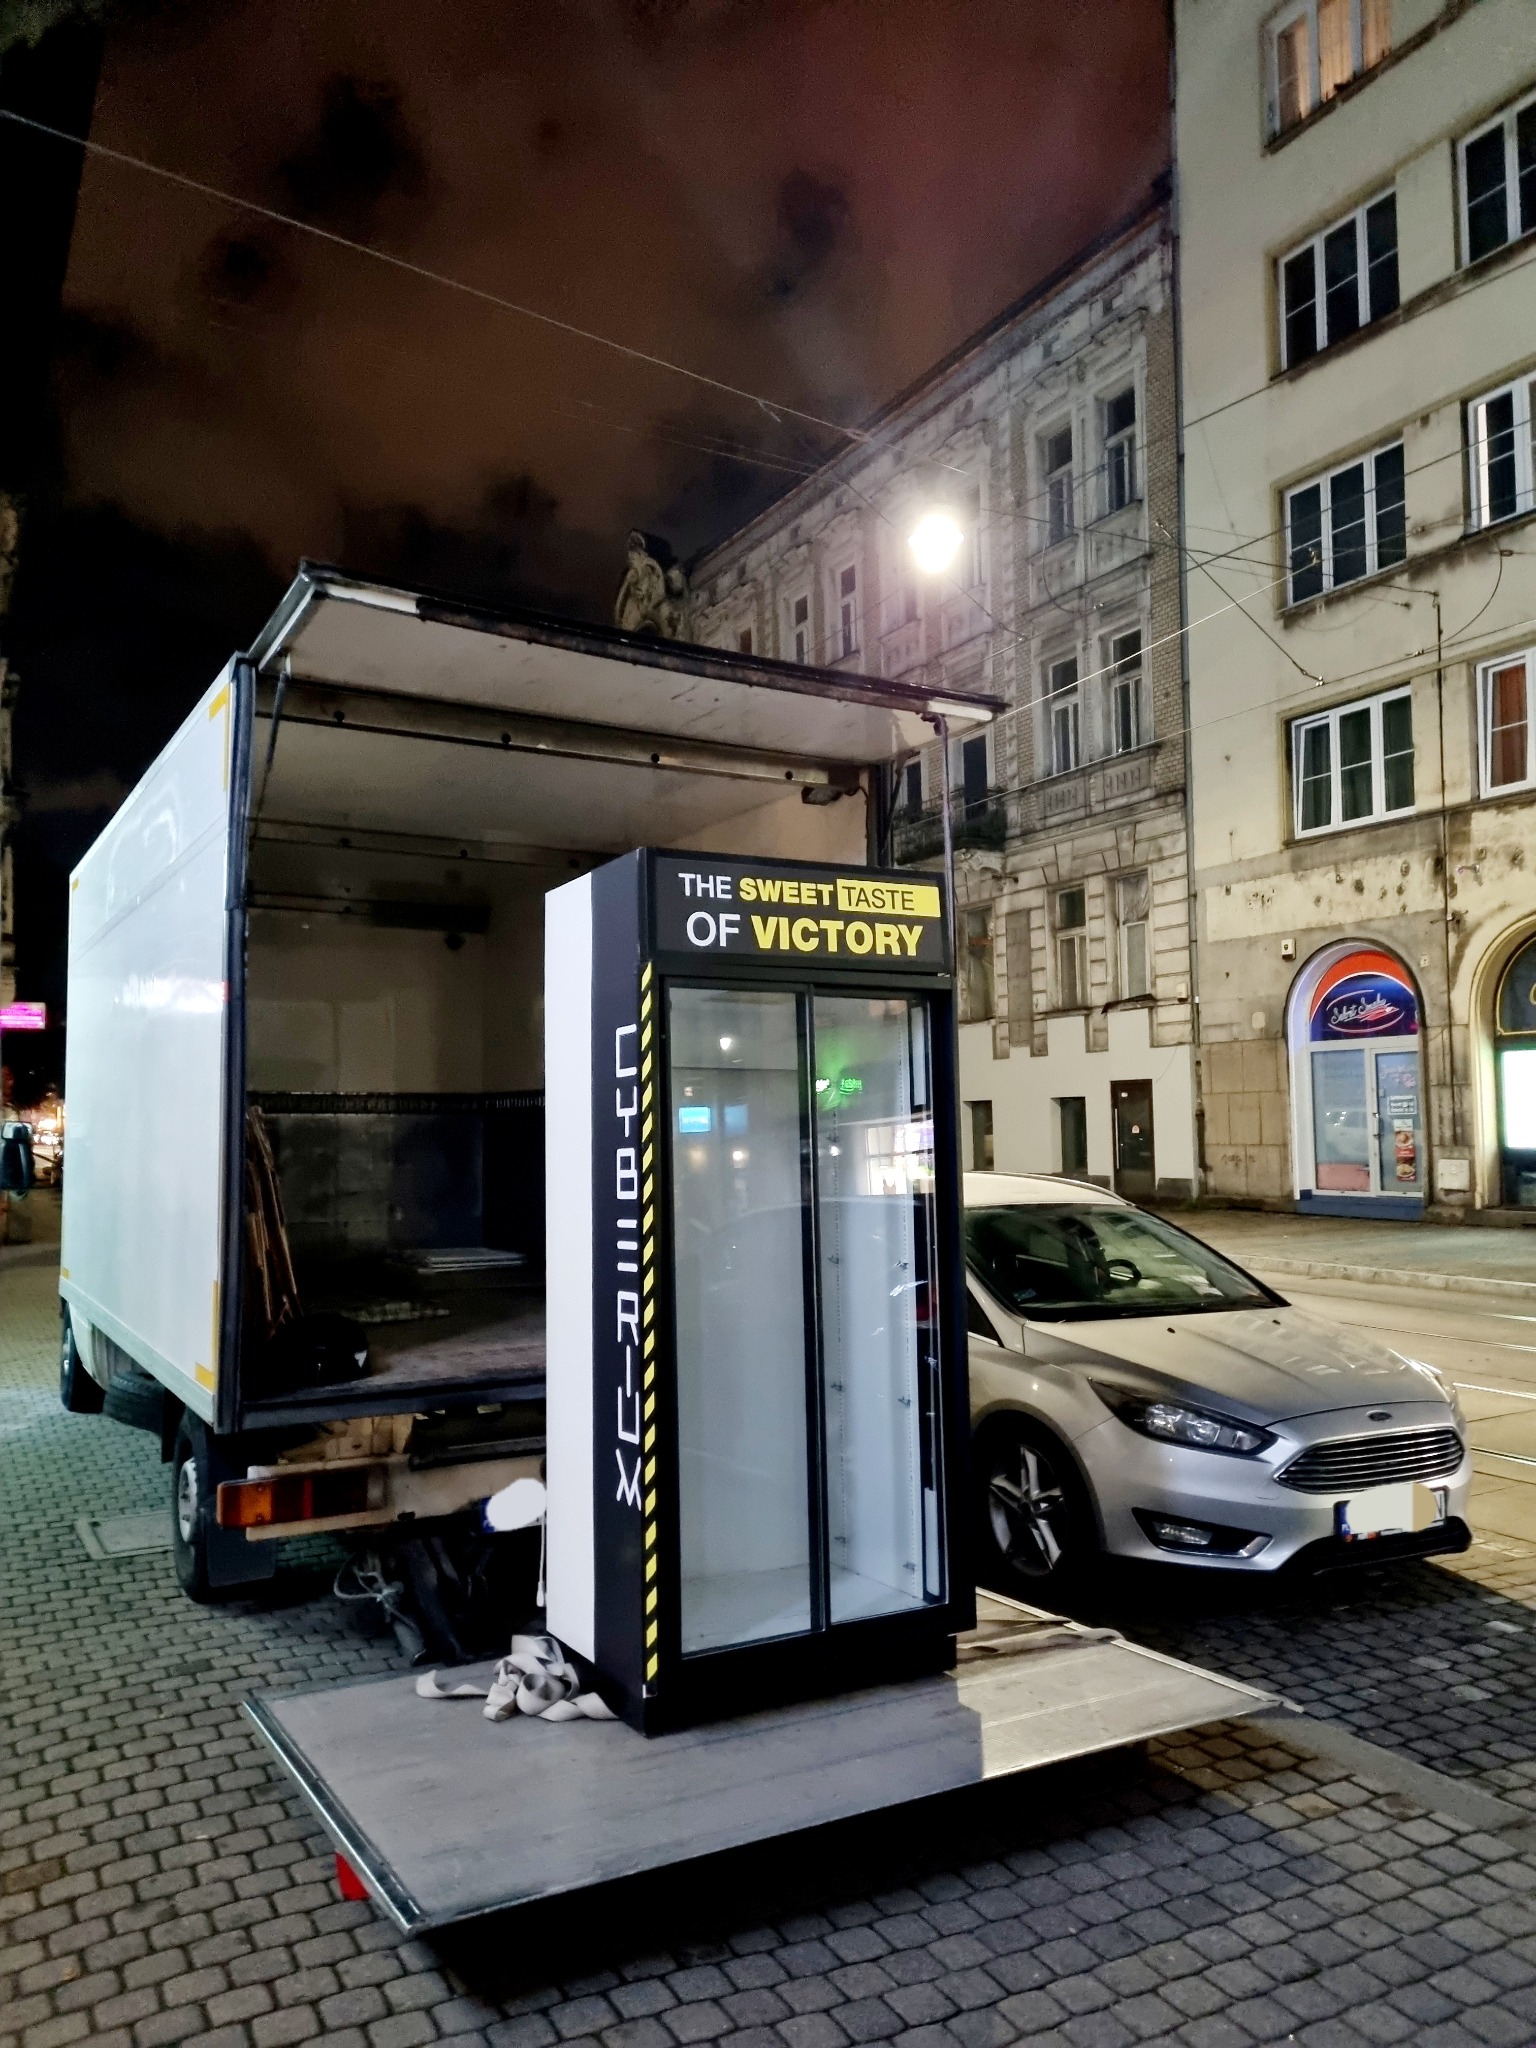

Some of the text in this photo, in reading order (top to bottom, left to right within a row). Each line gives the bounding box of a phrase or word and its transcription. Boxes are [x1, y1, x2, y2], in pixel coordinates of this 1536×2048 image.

[678, 873, 915, 910] THE SWEET TASTE
[686, 911, 923, 956] OF VICTORY
[615, 1024, 641, 1511] CYBERIUM
